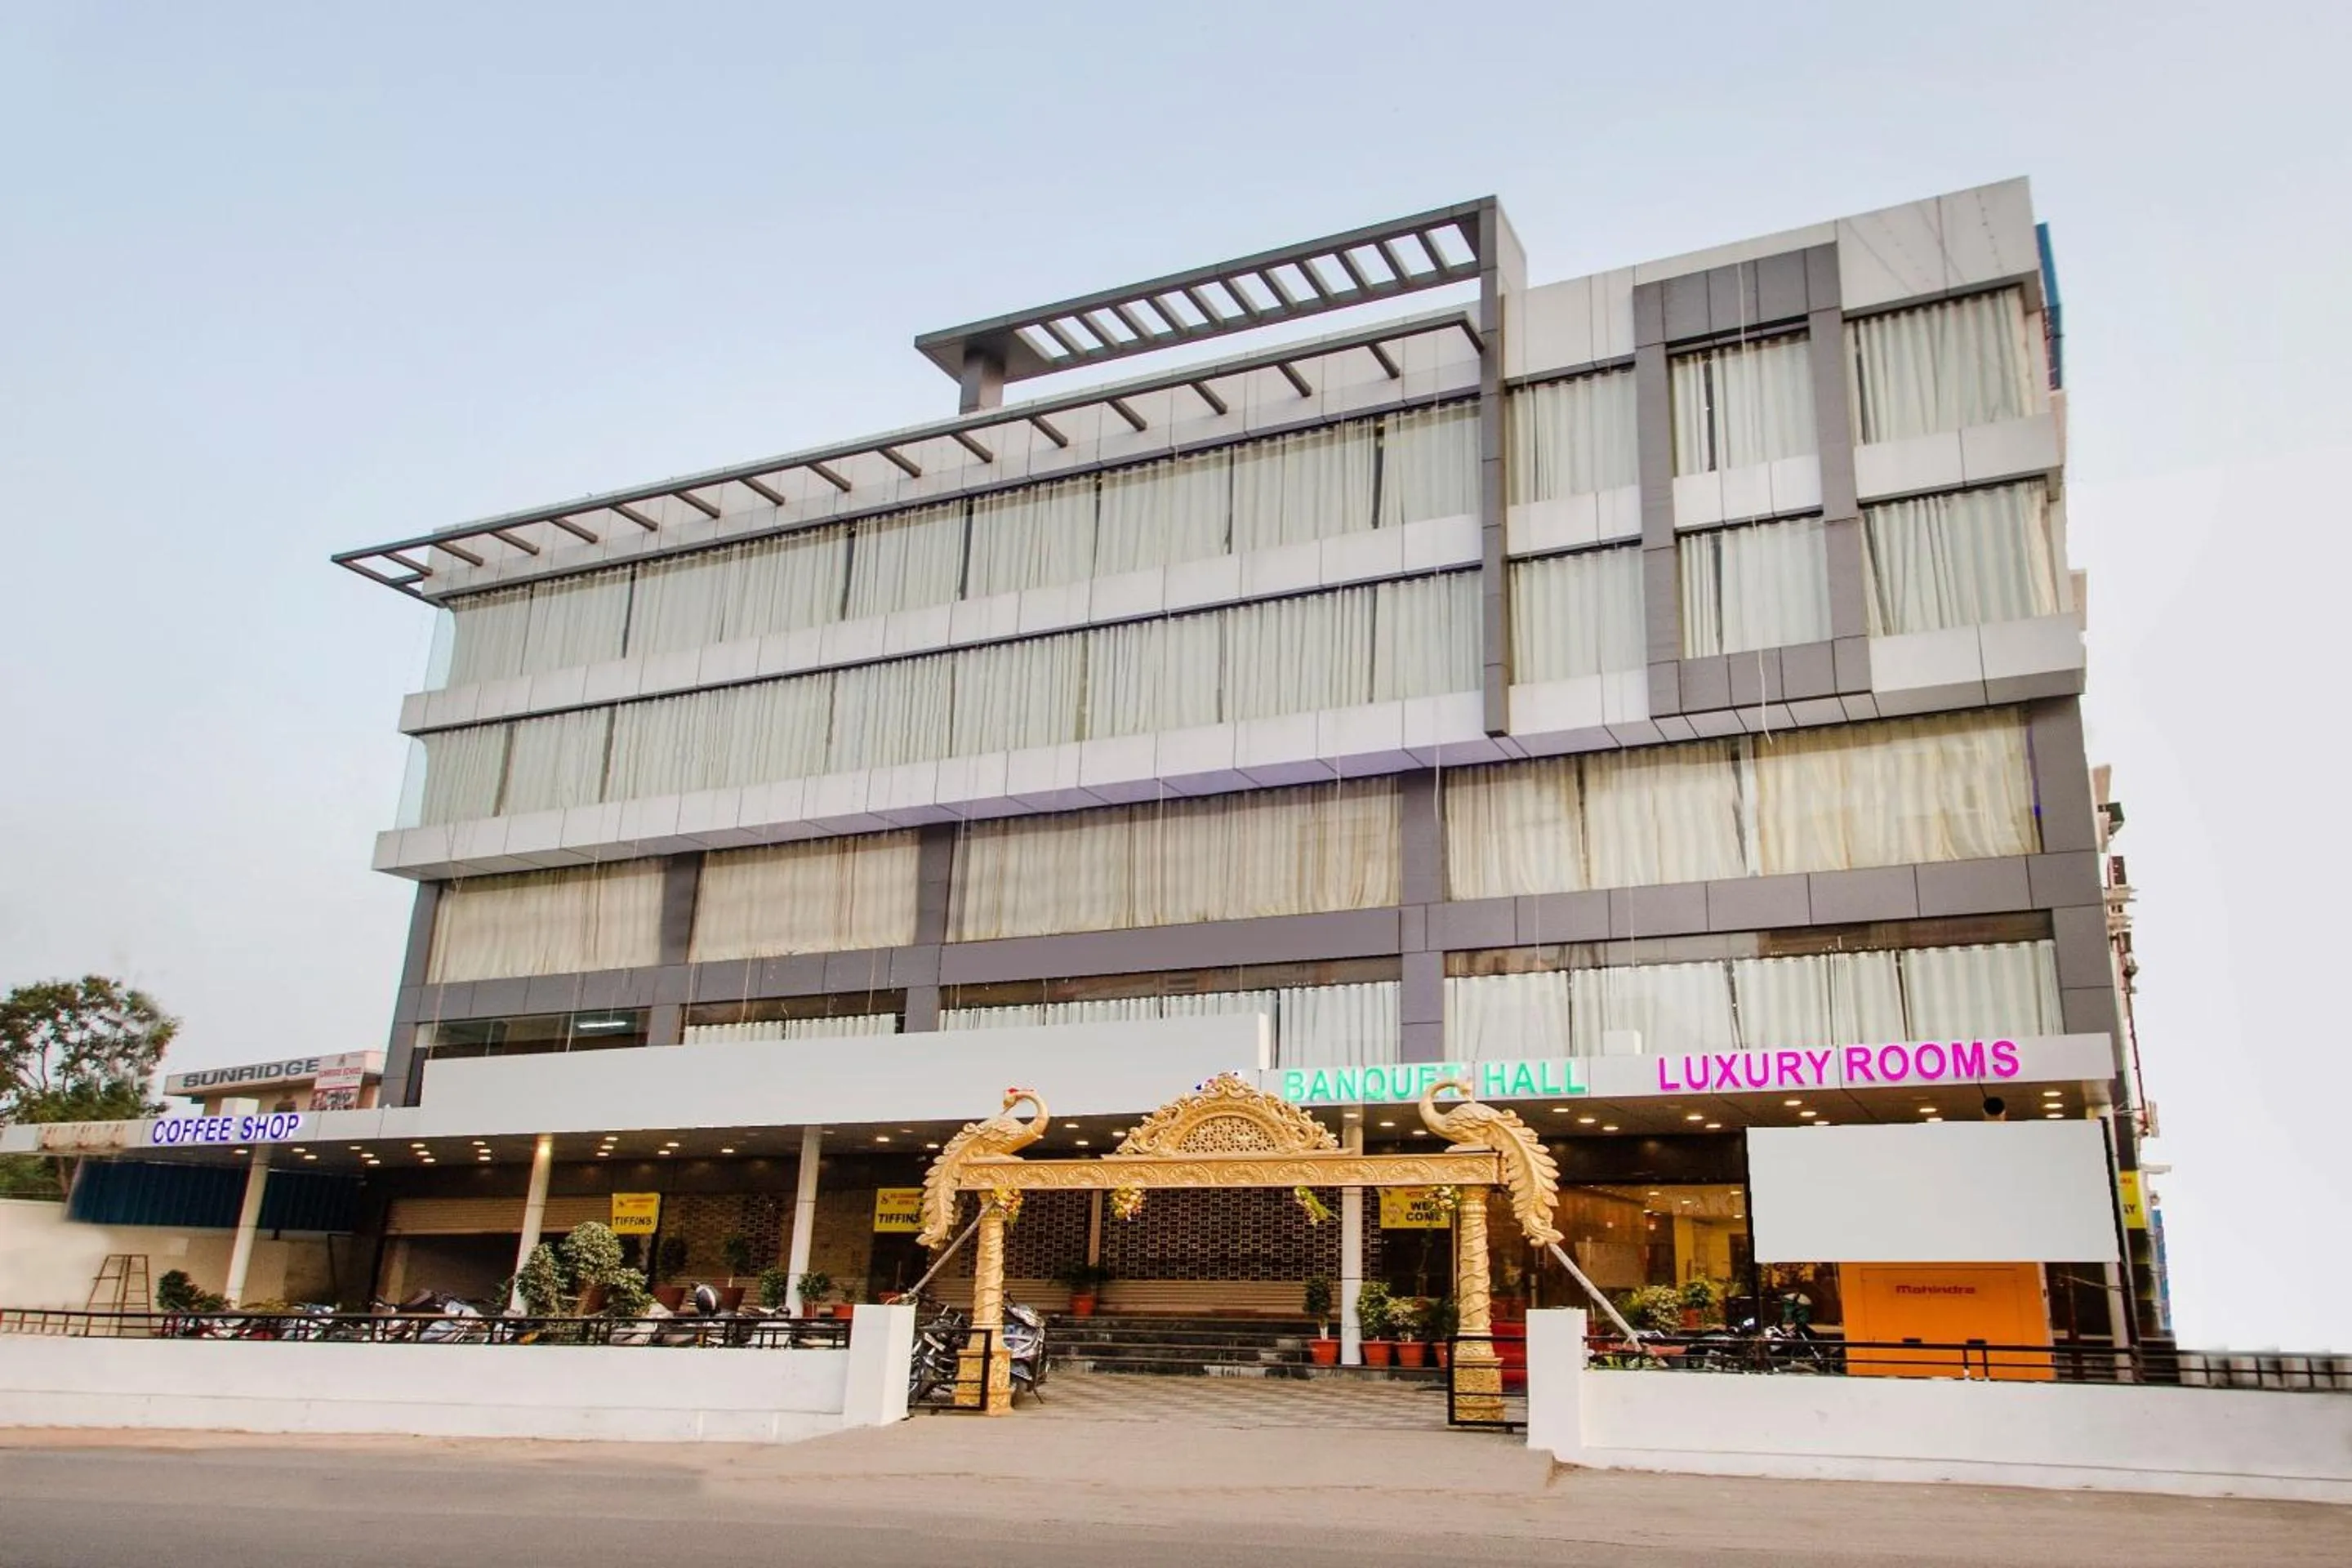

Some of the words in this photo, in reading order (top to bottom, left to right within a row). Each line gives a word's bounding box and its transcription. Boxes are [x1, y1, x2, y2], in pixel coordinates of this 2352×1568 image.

[184, 1059, 318, 1087] SUNRIDGE
[1483, 1061, 1588, 1097] HALL
[1659, 1051, 1832, 1091] LUXURY
[1845, 1040, 2020, 1081] ROOMS
[153, 1117, 232, 1143] COFFEE
[240, 1114, 299, 1140] SHOP
[614, 1216, 653, 1226] TIFFINS
